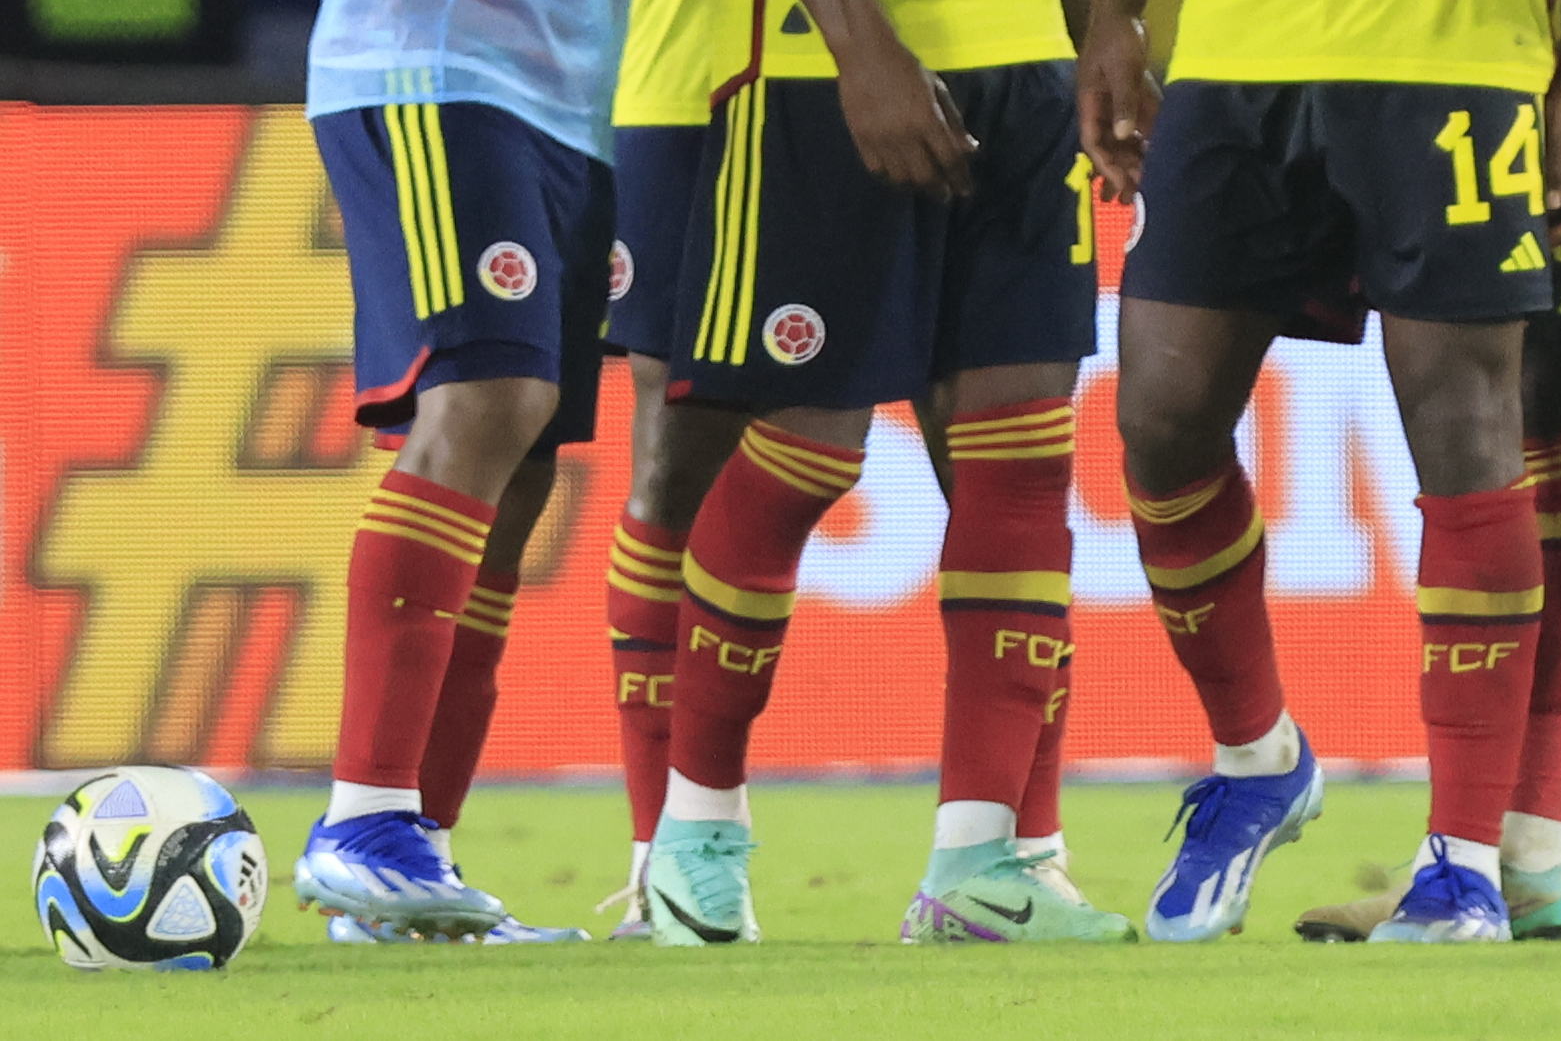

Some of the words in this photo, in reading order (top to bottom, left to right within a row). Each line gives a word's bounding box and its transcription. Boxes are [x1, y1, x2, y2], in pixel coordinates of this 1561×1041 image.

[1434, 103, 1546, 226] 14
[690, 625, 782, 675] FCF
[1422, 641, 1521, 673] FCF
